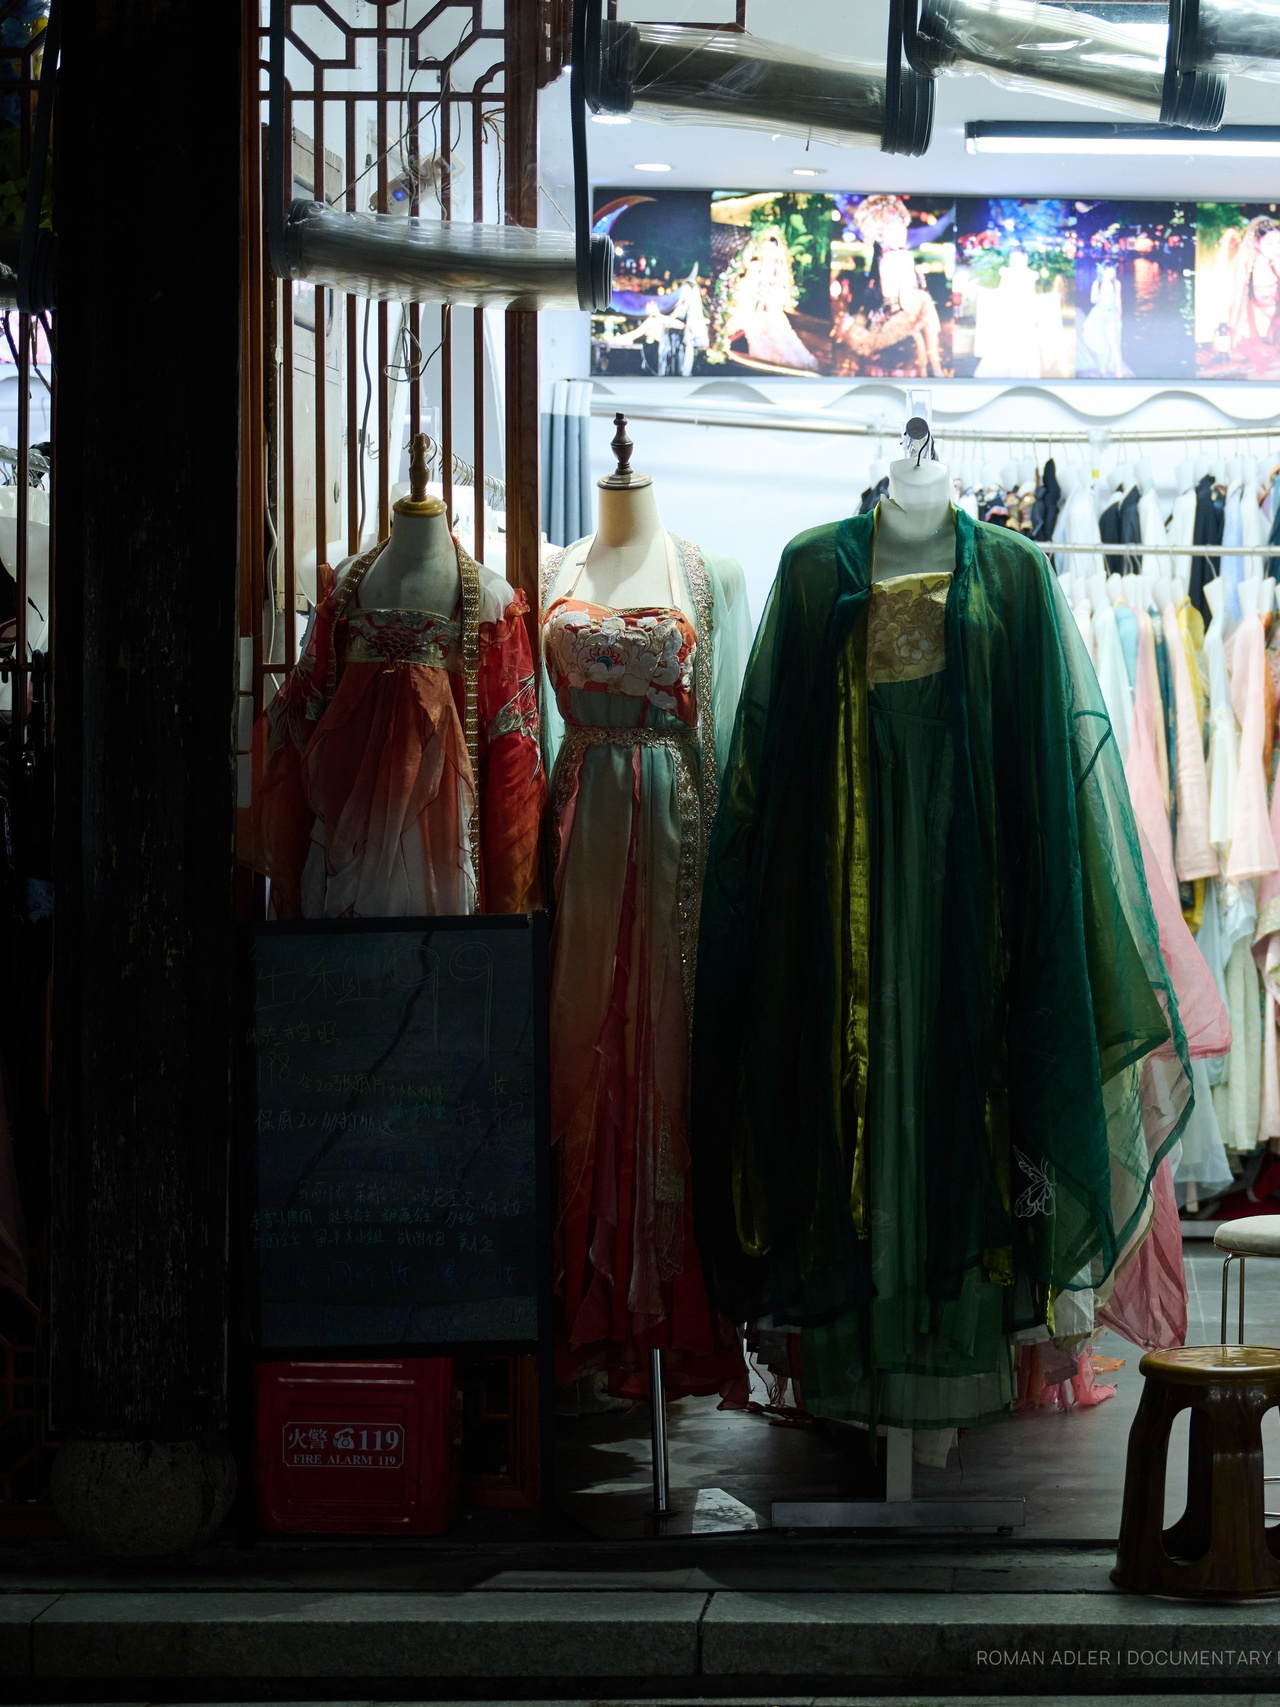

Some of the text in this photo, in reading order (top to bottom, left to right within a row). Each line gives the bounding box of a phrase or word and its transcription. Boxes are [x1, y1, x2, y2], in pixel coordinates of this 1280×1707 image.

[387, 940, 495, 1066] 99
[288, 1428, 400, 1451] 火警 119
[293, 1454, 396, 1466] FIRE ALARM 119
